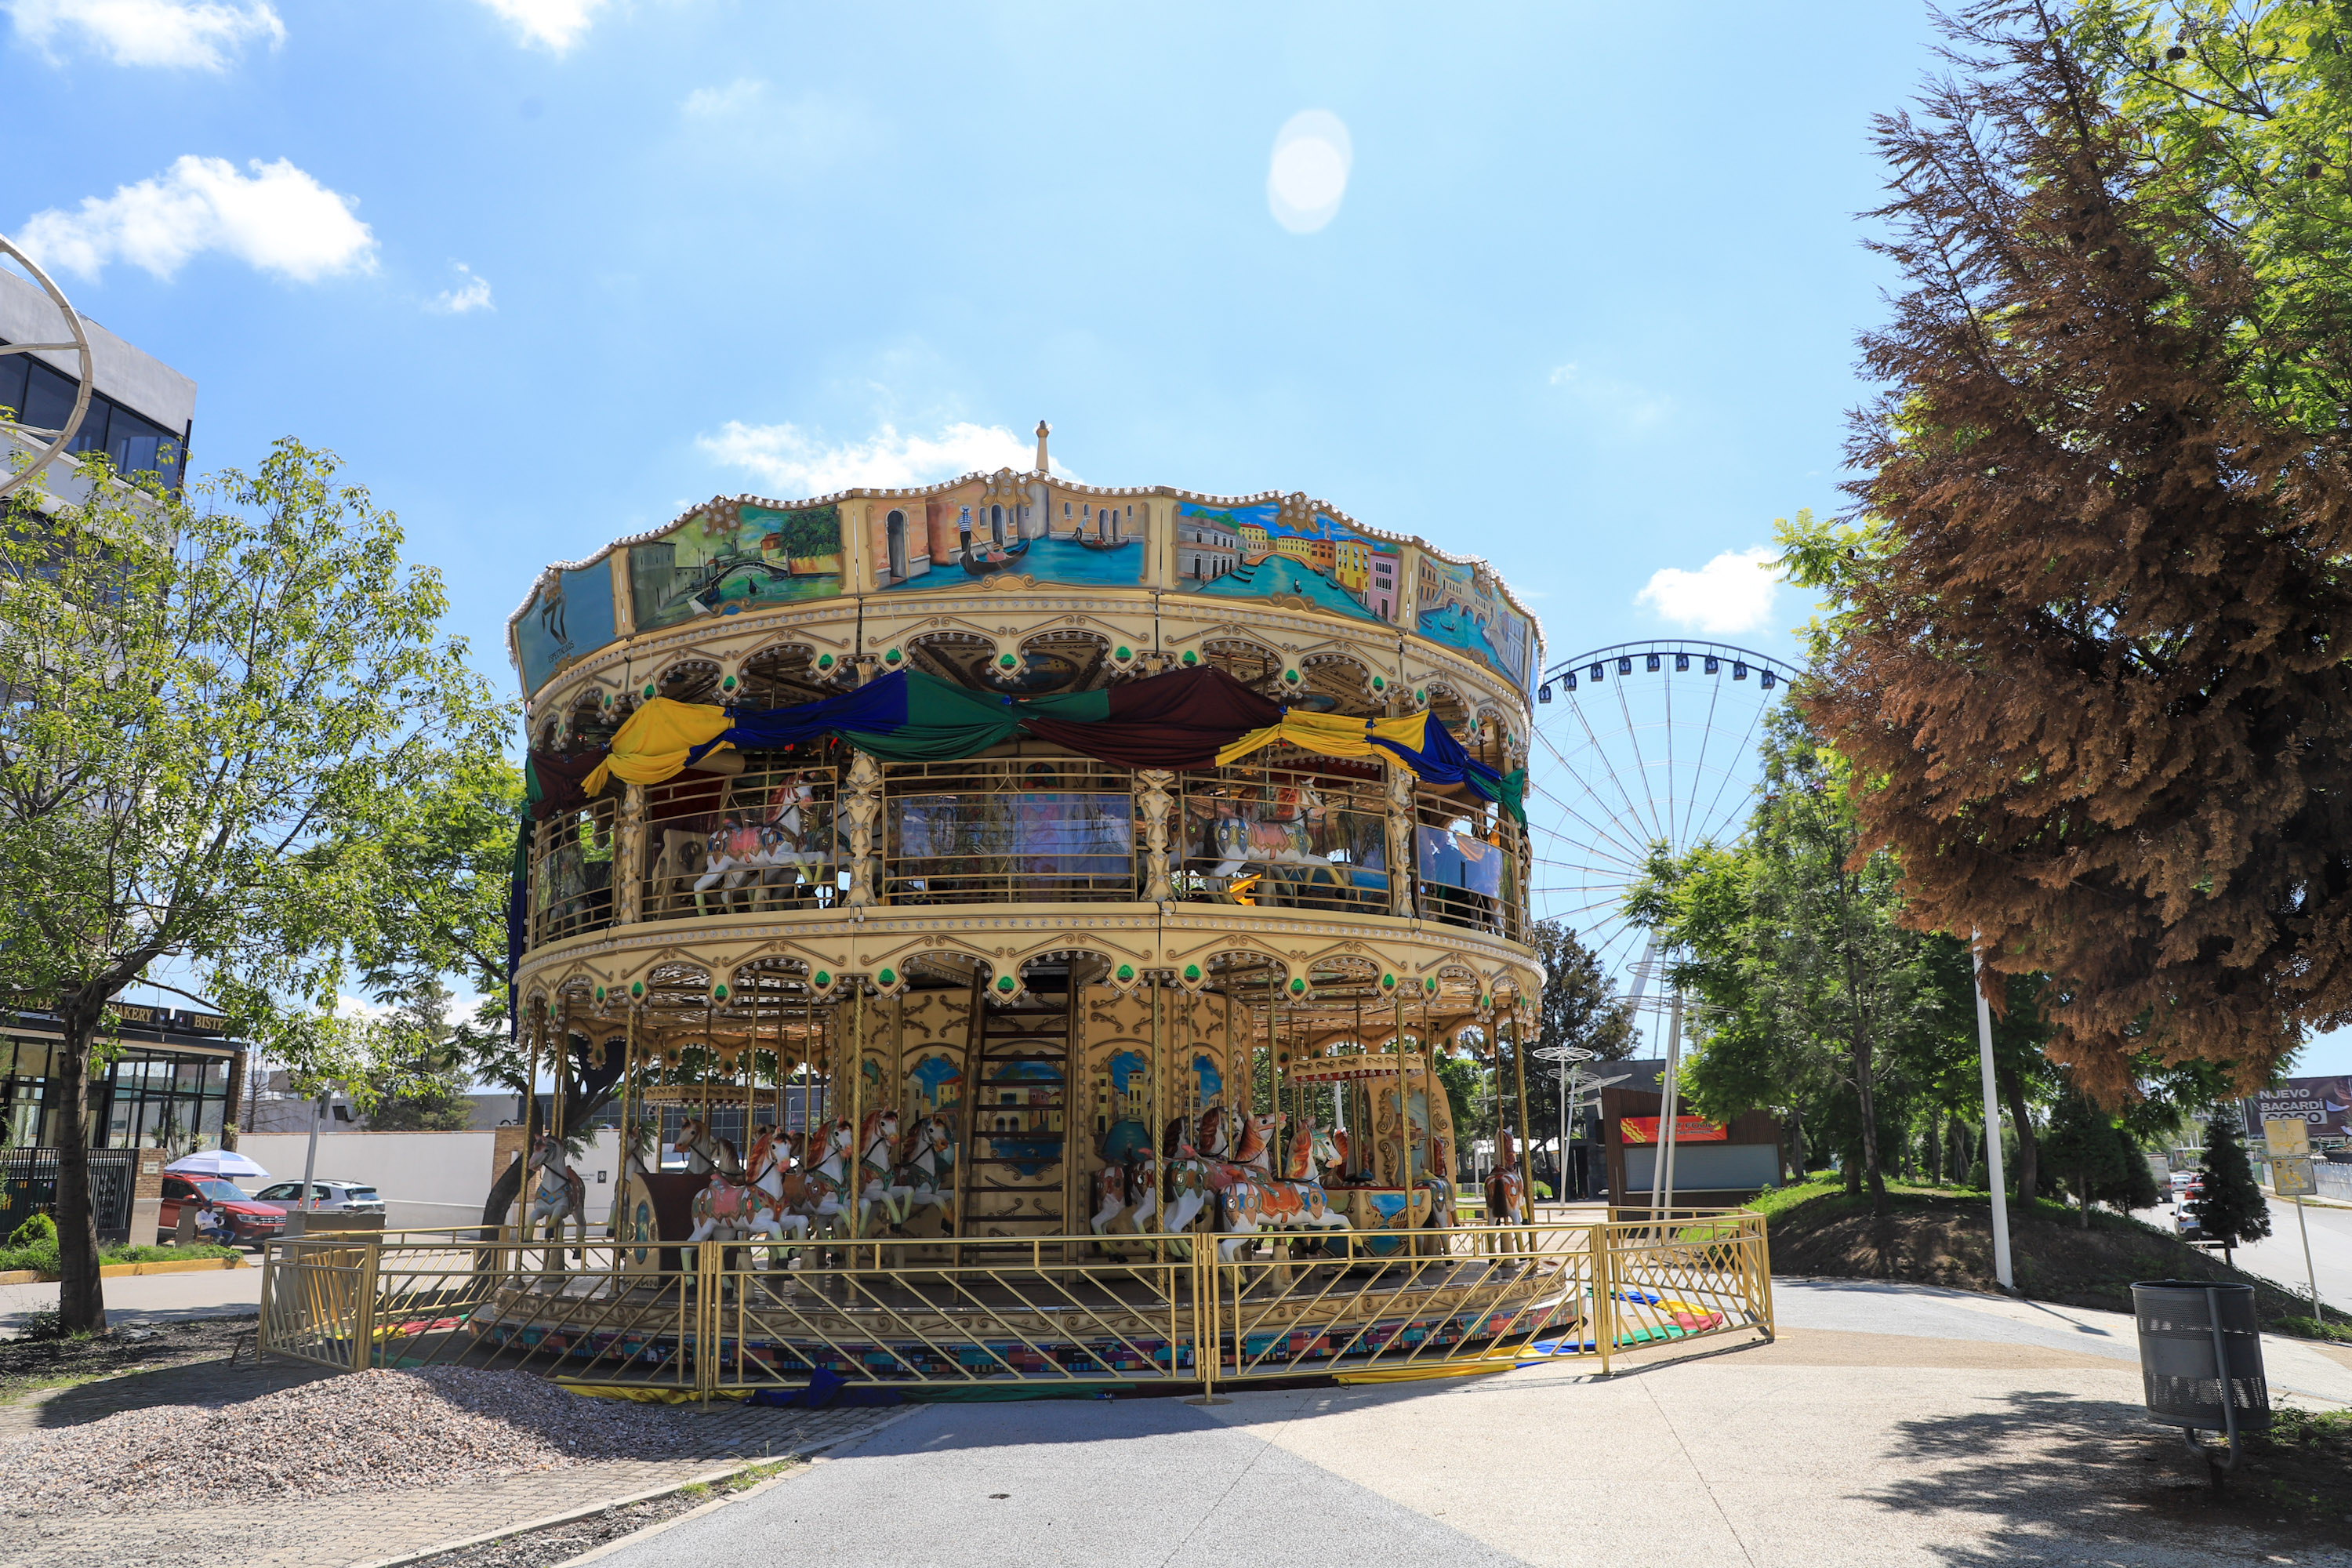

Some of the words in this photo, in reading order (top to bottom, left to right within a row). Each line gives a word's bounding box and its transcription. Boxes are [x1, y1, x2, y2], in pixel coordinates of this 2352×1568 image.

[194, 1014, 225, 1031] BISTR
[2259, 1088, 2310, 1100] NUEVO
[2260, 1098, 2324, 1112] BACARDÍ
